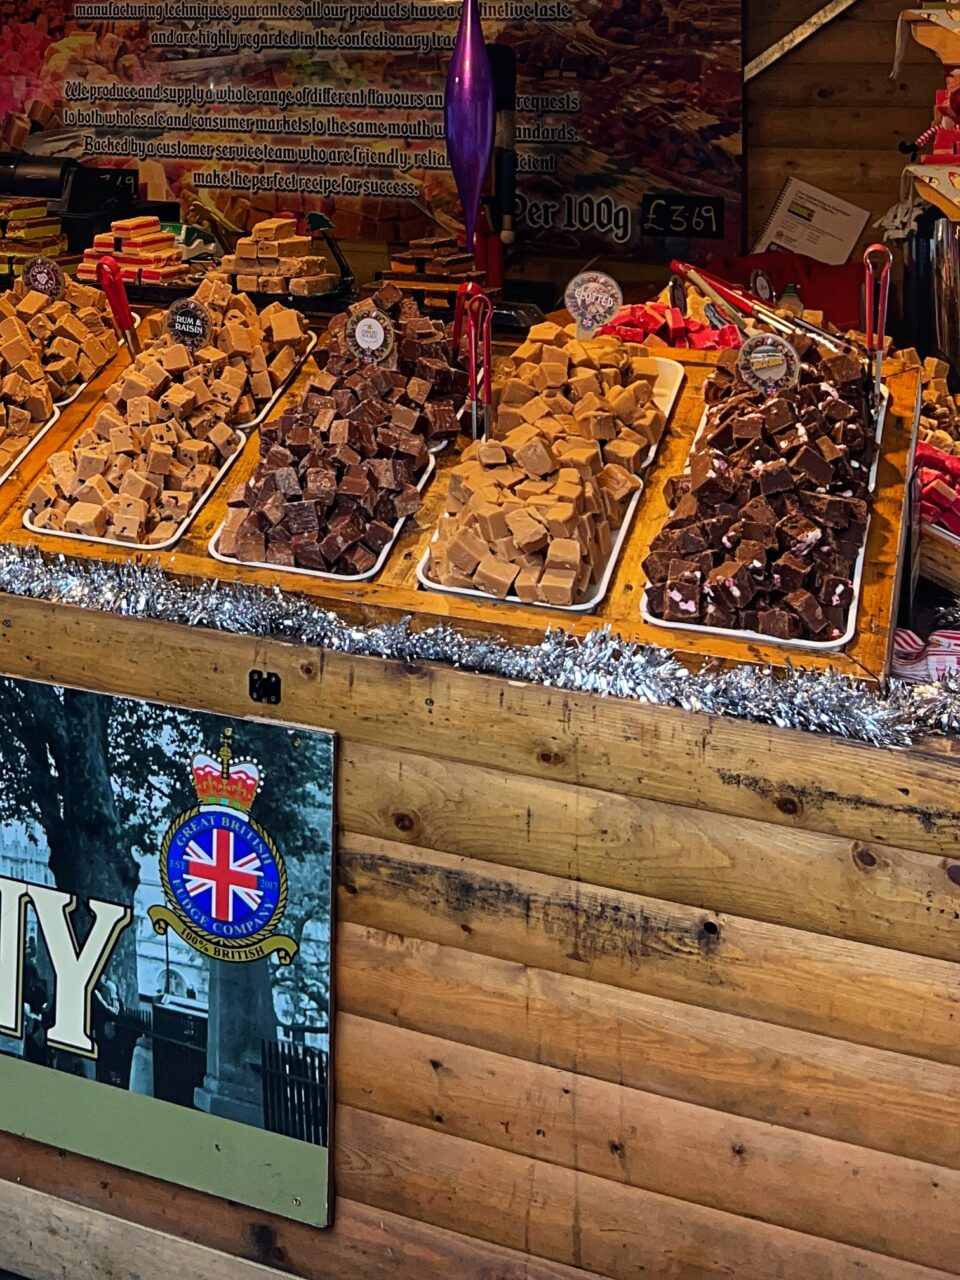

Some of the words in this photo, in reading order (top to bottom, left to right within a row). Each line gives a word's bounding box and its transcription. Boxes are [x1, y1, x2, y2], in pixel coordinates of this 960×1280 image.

[74, 1, 165, 24] manufacturing
[165, 1, 230, 24] techniques
[231, 2, 302, 24] guarantees
[304, 1, 321, 18] all
[322, 4, 348, 18] our
[348, 1, 408, 22] products
[410, 1, 446, 18] have
[446, 4, 455, 18] a
[456, 1, 534, 18] dtinctive
[534, 1, 571, 18] taste
[150, 29, 175, 45] and
[176, 33, 198, 46] are
[198, 29, 240, 50] highly
[240, 29, 299, 51] regarded
[300, 30, 312, 47] in
[314, 30, 337, 47] the
[337, 30, 430, 52] confectionary
[431, 31, 457, 48] tra
[65, 81, 89, 100] We
[89, 83, 138, 103] produce
[138, 83, 162, 100] and
[162, 83, 204, 105] supply
[205, 87, 213, 101] a
[213, 86, 256, 103] whole
[256, 89, 294, 108] range
[294, 87, 311, 104] of
[310, 87, 366, 105] different
[366, 88, 424, 106] flavours
[425, 93, 444, 107] an
[516, 93, 580, 115] requests
[63, 109, 76, 125] to
[77, 109, 103, 126] both
[104, 110, 166, 129] wholesale
[166, 111, 190, 129] and
[191, 116, 253, 131] consumer
[256, 116, 310, 133] markets
[310, 116, 325, 133] to
[326, 117, 350, 134] the
[349, 120, 387, 135] same
[387, 119, 431, 137] mouth
[515, 122, 580, 142] andards.
[83, 135, 129, 154] Backed
[130, 138, 147, 159] by
[147, 142, 155, 155] a
[156, 141, 214, 158] customer
[215, 143, 263, 161] service
[263, 144, 297, 162] team
[297, 145, 327, 162] who
[328, 149, 353, 163] are
[352, 147, 413, 170] friendly,
[413, 150, 450, 167] relia
[516, 152, 557, 171] icient
[192, 169, 228, 187] make
[228, 170, 250, 188] the
[250, 171, 297, 191] perfect
[298, 174, 340, 195] recipe
[340, 175, 362, 193] for
[362, 179, 420, 197] success.
[560, 193, 631, 244] 100g
[575, 289, 614, 308] CLOTTED
[175, 323, 203, 334] RAISIN
[176, 315, 194, 325] RUM
[195, 318, 202, 326] &
[176, 815, 216, 847] GREAT
[221, 816, 273, 865] BRITISH
[173, 879, 208, 927] FUDGE
[212, 903, 274, 936] COMPANY
[181, 929, 209, 953] 100%
[213, 946, 266, 960] BRITISH
